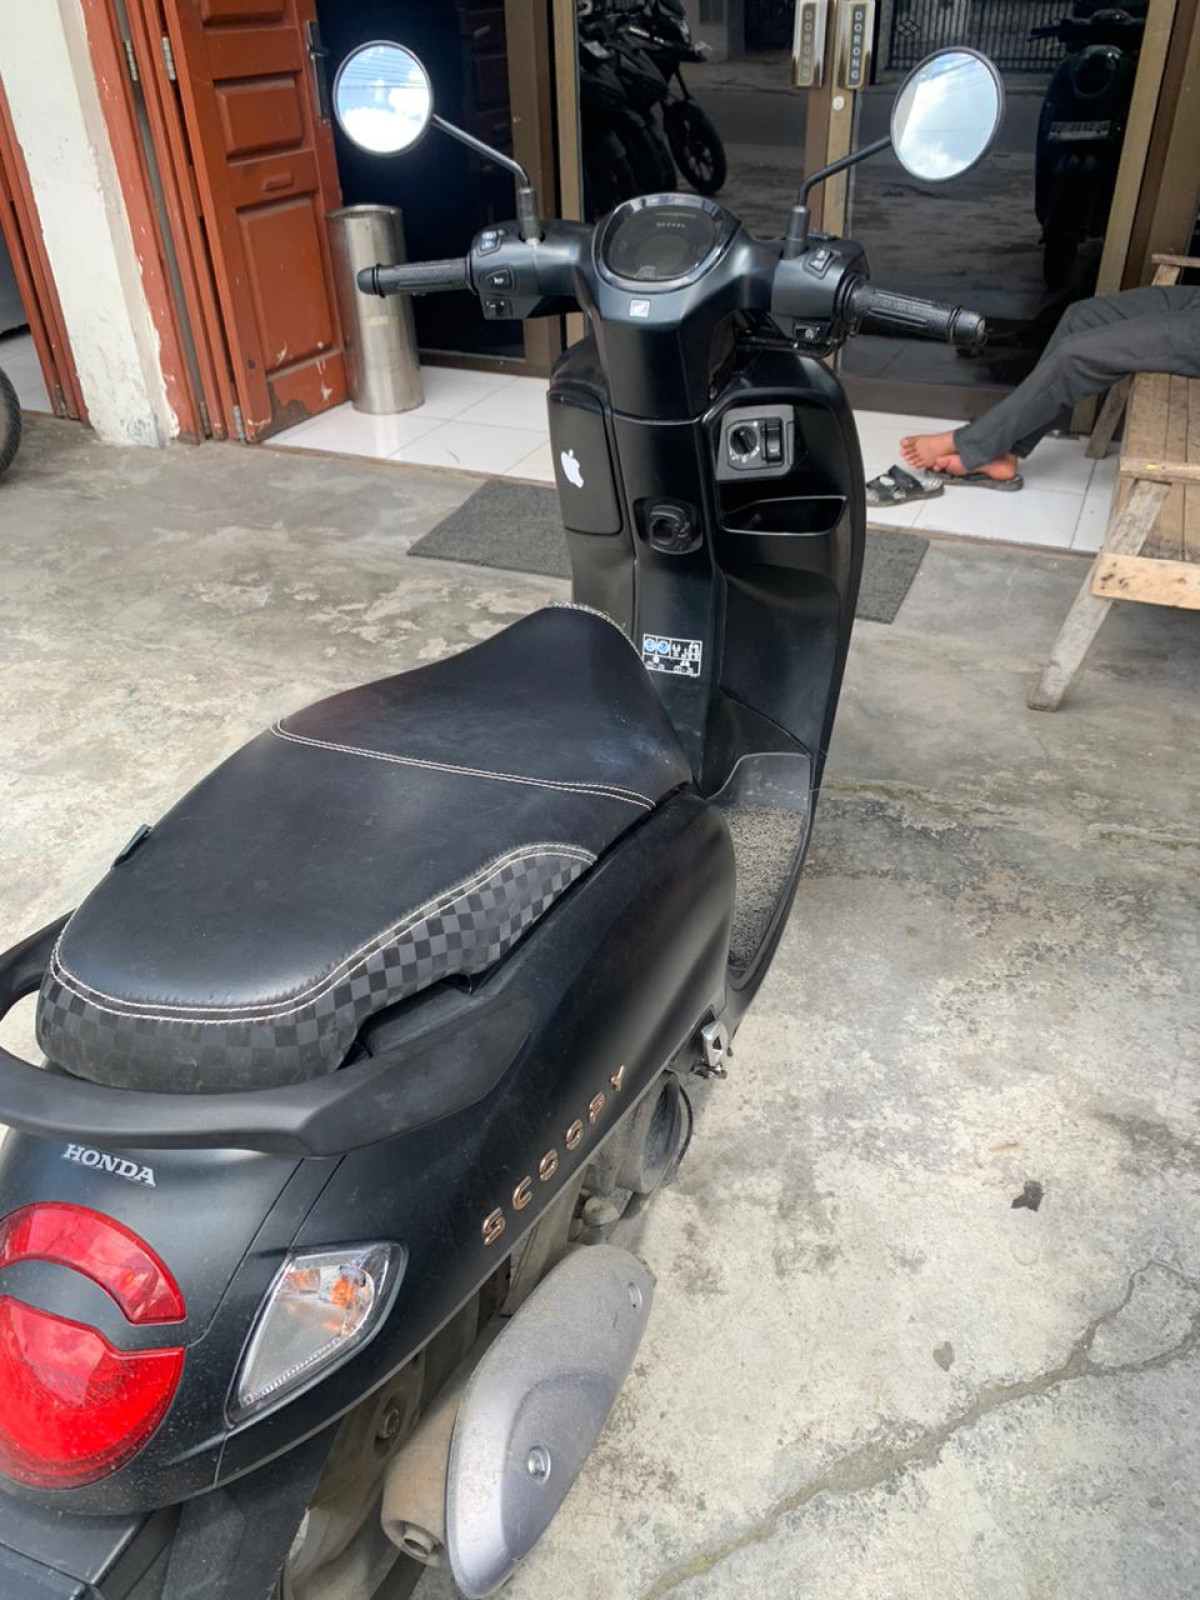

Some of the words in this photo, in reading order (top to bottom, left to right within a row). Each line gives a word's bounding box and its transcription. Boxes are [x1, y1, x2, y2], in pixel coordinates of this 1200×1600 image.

[850, 10, 863, 80] DORONG
[61, 1142, 156, 1188] HONDA
[482, 1064, 626, 1246] SCOOPY
